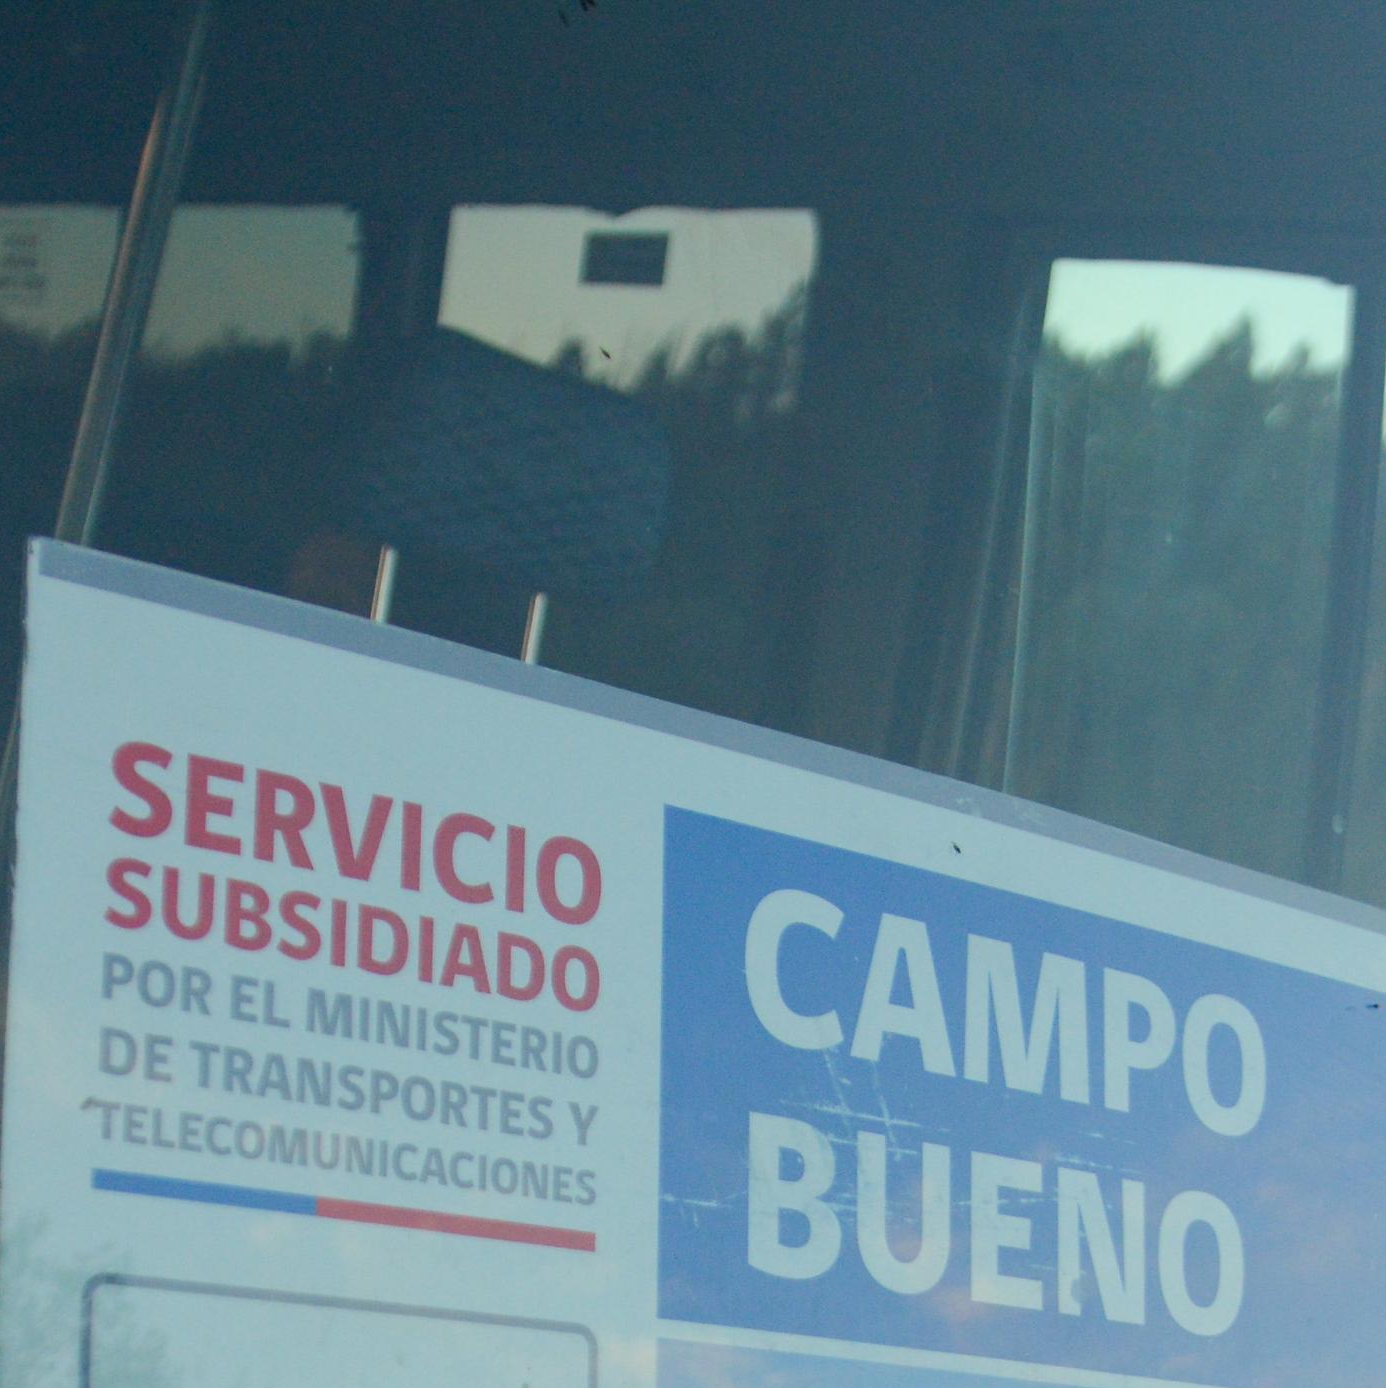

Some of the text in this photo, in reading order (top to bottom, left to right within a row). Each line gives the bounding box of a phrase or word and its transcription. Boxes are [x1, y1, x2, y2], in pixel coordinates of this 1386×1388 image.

[108, 741, 602, 925] SERVICIO
[103, 857, 601, 1012] SUBSIDIADO
[98, 1027, 600, 1146] DE TRANSPORTES Y
[100, 951, 599, 1079] POR EL MINISTERIO
[744, 889, 1268, 1137] CAMPO
[94, 1098, 597, 1206] TELECOMUNICACIONES
[747, 1111, 1246, 1336] BUENO
